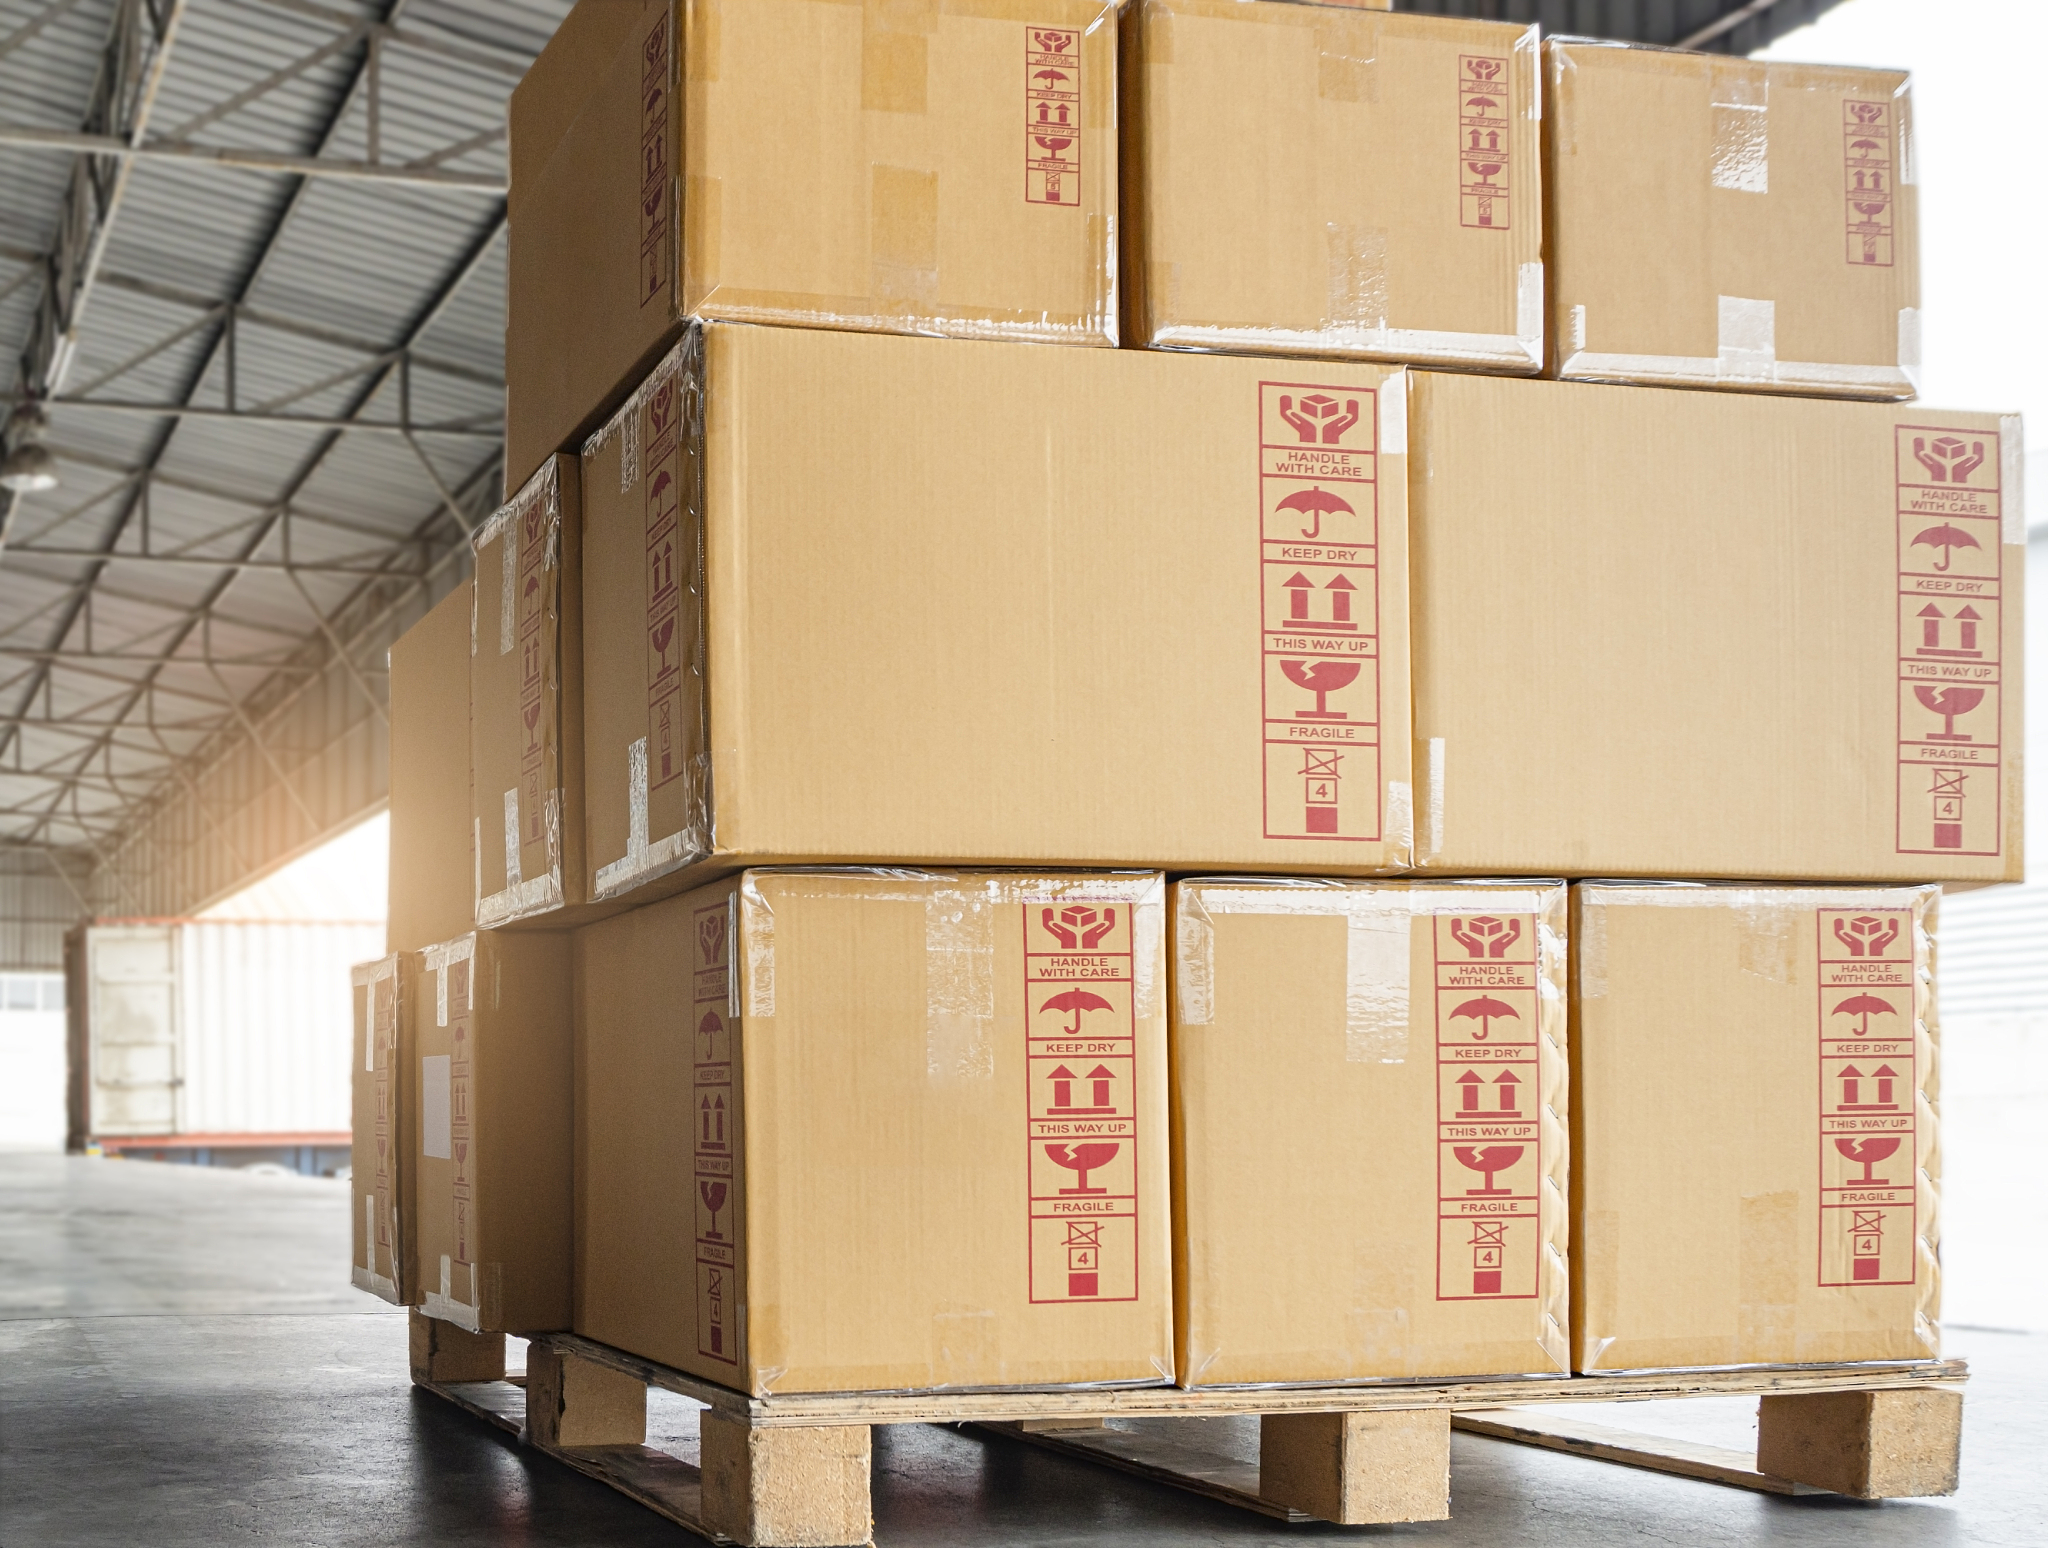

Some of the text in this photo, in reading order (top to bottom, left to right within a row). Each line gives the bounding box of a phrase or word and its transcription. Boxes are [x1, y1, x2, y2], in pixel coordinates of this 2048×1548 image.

[1288, 451, 1350, 465] HANDLE
[1276, 462, 1361, 476] WITH CARE
[1921, 490, 1977, 503] HANDLE
[1911, 500, 1987, 514] WITH CARE
[1282, 548, 1357, 561] KEEP DRY
[1916, 579, 1983, 593] KEEP DRY
[1273, 638, 1368, 652] THIS WAY UP
[1908, 664, 1992, 678] THIS WAY UP
[1289, 726, 1355, 739] FRAGILE
[1921, 748, 1978, 760] FRAGILE
[1315, 783, 1328, 798] 4
[1943, 801, 1954, 814] 4
[1051, 958, 1108, 967] HANDLE
[1040, 967, 1119, 977] WITH CARE
[1459, 966, 1514, 975] HANDLE
[1841, 964, 1892, 973] HANDLE
[1449, 976, 1525, 985] WITH CARE
[1832, 974, 1902, 983] WITH CARE
[1046, 1043, 1115, 1053] KEEP DRY
[1455, 1048, 1521, 1058] KEEP DRY
[1837, 1044, 1898, 1053] KEEP DRY
[1038, 1123, 1126, 1134] THIS WAY UP
[1829, 1119, 1907, 1129] THIS WAY UP
[1448, 1126, 1531, 1136] THIS WAY UP
[1842, 1192, 1895, 1202] FRAGILE
[1053, 1202, 1114, 1212] FRAGILE
[1461, 1202, 1518, 1212] FRAGILE
[1862, 1239, 1872, 1251] 4
[704, 1247, 726, 1260] FRAGILE
[1077, 1252, 1088, 1265] 4
[1483, 1252, 1494, 1263] 4
